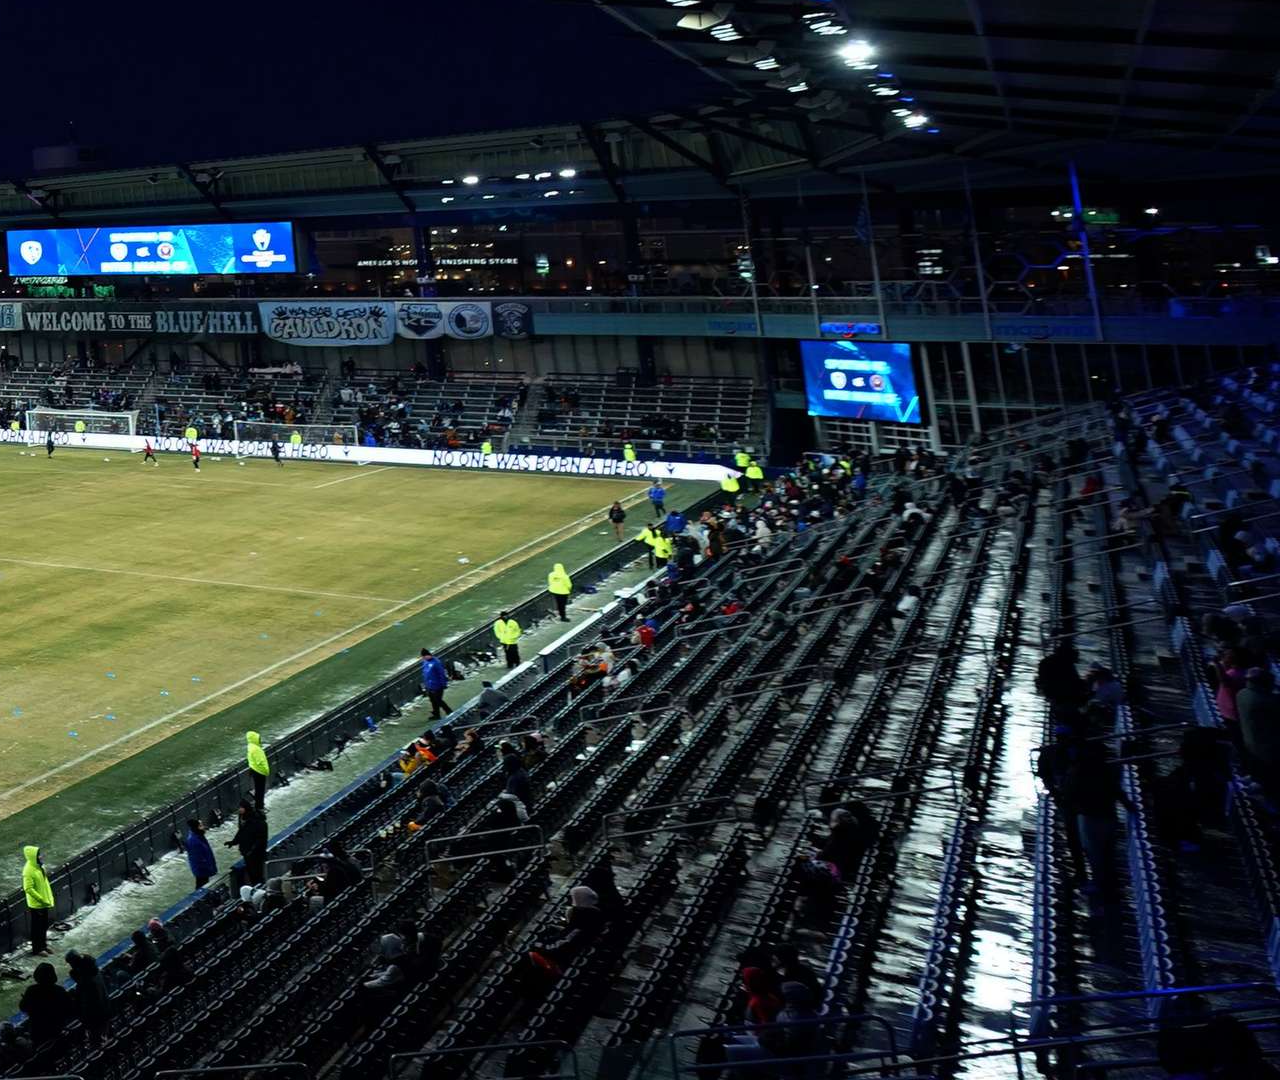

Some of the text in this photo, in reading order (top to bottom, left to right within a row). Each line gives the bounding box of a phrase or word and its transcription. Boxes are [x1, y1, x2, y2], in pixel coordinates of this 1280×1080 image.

[488, 257, 519, 265] STORE
[26, 311, 258, 334] WELCOME TO THE BLUE HELL
[271, 316, 389, 340] CAULDRON
[38, 430, 72, 445] HRO.
[154, 436, 174, 450] NO
[205, 439, 235, 454] WAS
[433, 450, 454, 466] NO
[459, 451, 491, 467] ONE
[494, 453, 531, 470] WAS
[537, 455, 582, 473] BORN
[586, 457, 599, 474] A
